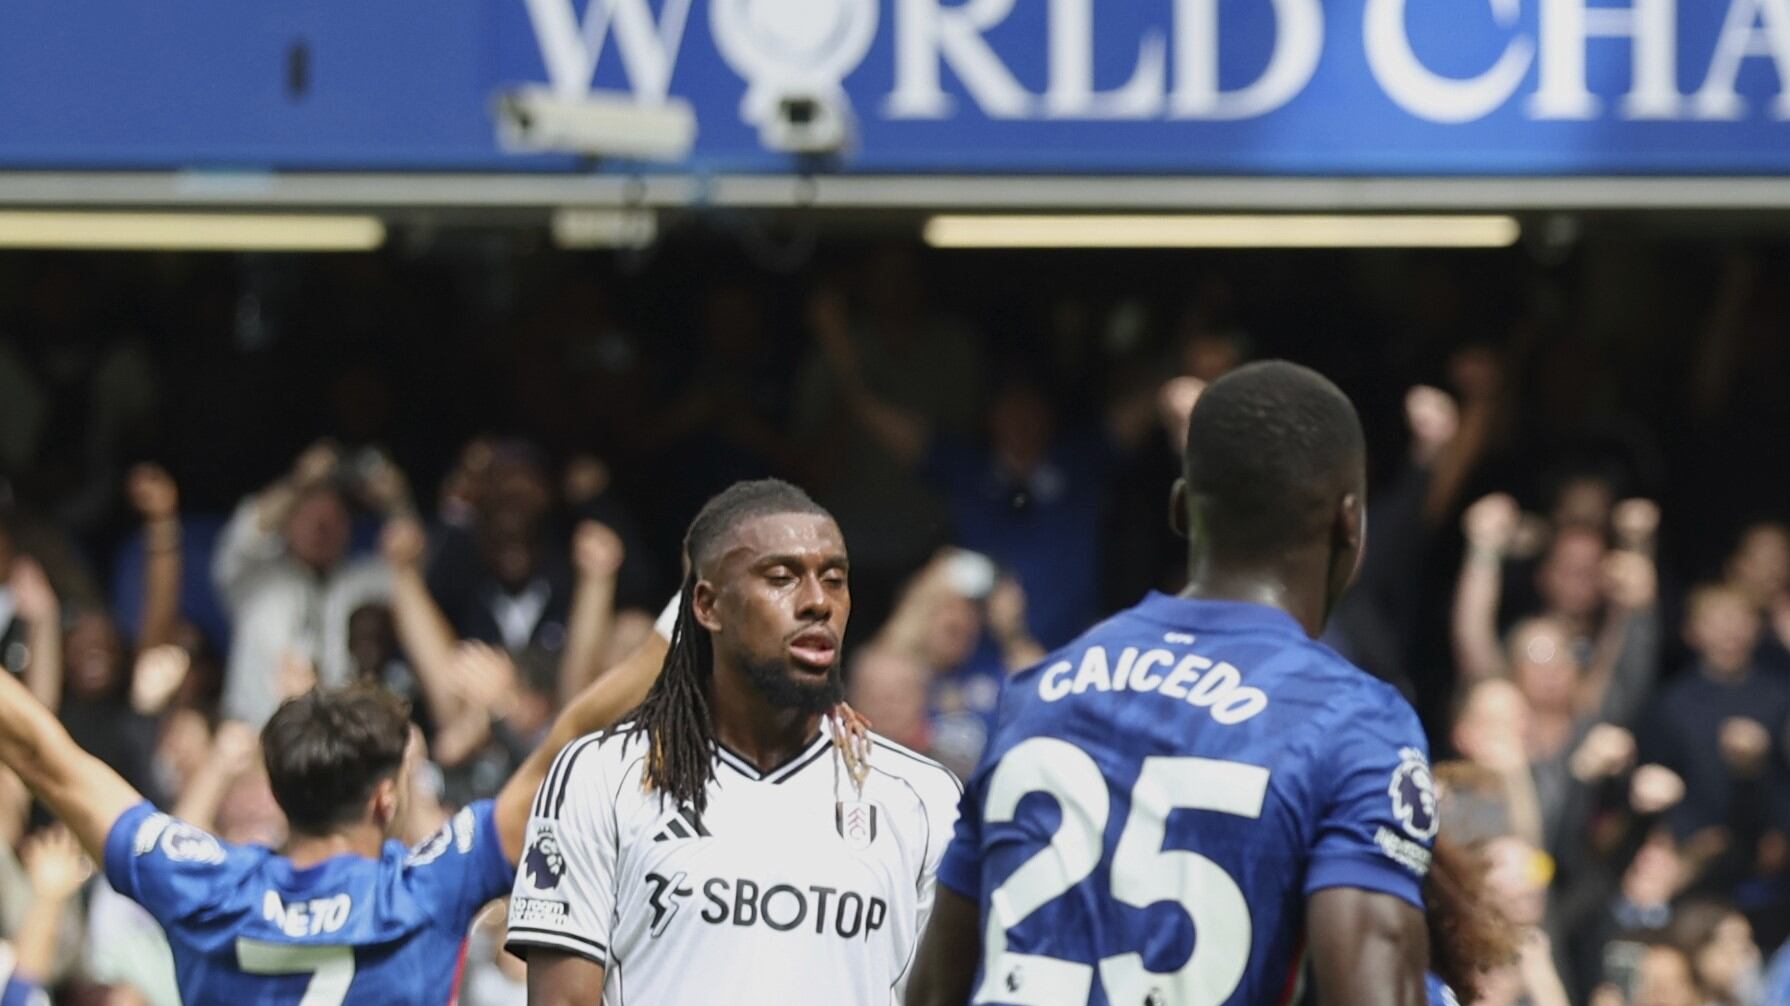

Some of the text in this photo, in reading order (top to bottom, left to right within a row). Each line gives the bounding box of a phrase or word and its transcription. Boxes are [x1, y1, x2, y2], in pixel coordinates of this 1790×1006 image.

[1038, 645, 1268, 726] CAICEDO
[262, 889, 352, 937] NETO
[701, 877, 887, 942] SBOTOP
